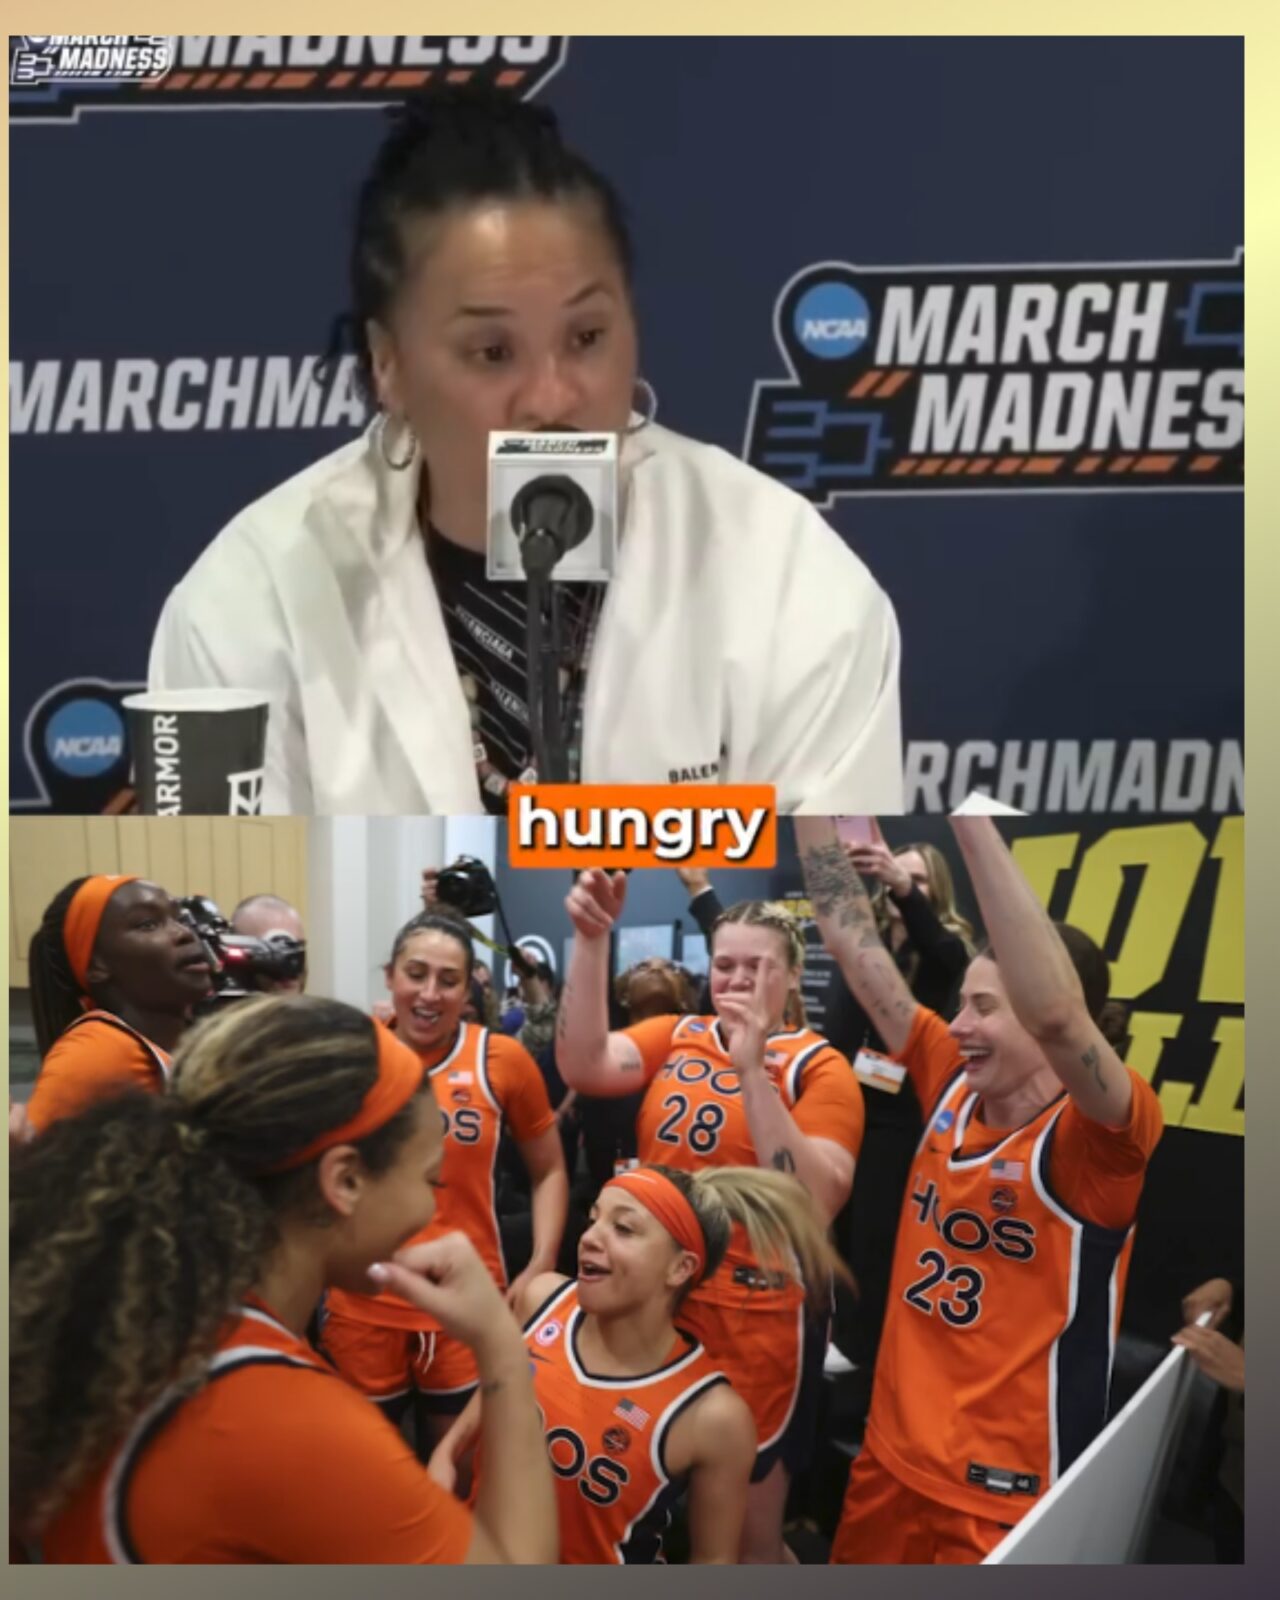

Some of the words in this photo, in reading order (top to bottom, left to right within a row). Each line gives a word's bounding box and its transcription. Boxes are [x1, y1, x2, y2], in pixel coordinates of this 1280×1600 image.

[802, 318, 867, 340] NCAA
[874, 282, 1169, 365] MARCH
[53, 735, 121, 757] NCAA
[656, 1094, 726, 1154] 28
[905, 1249, 986, 1328] 23
